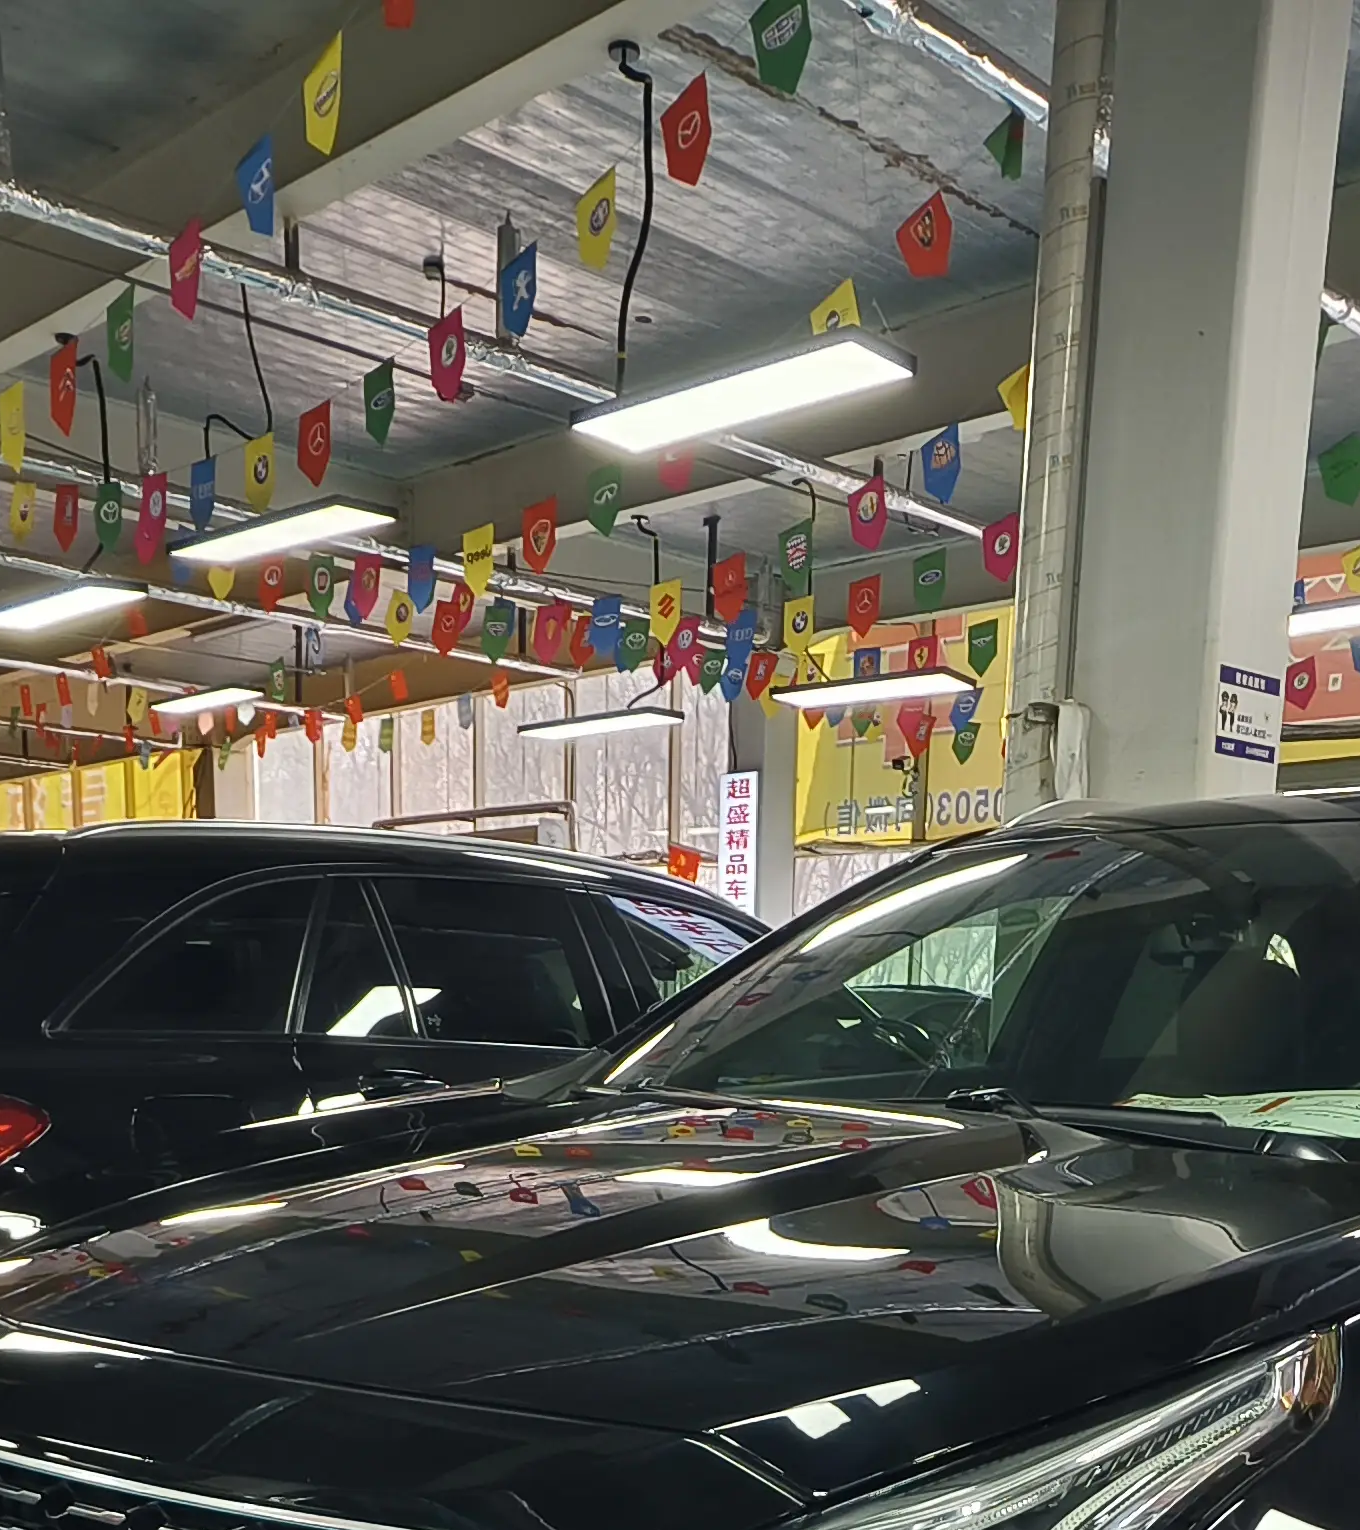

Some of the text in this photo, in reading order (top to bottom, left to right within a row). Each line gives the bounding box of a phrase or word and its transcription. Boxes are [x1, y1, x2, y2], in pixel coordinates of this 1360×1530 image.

[725, 778, 751, 907] 超盛精品车
